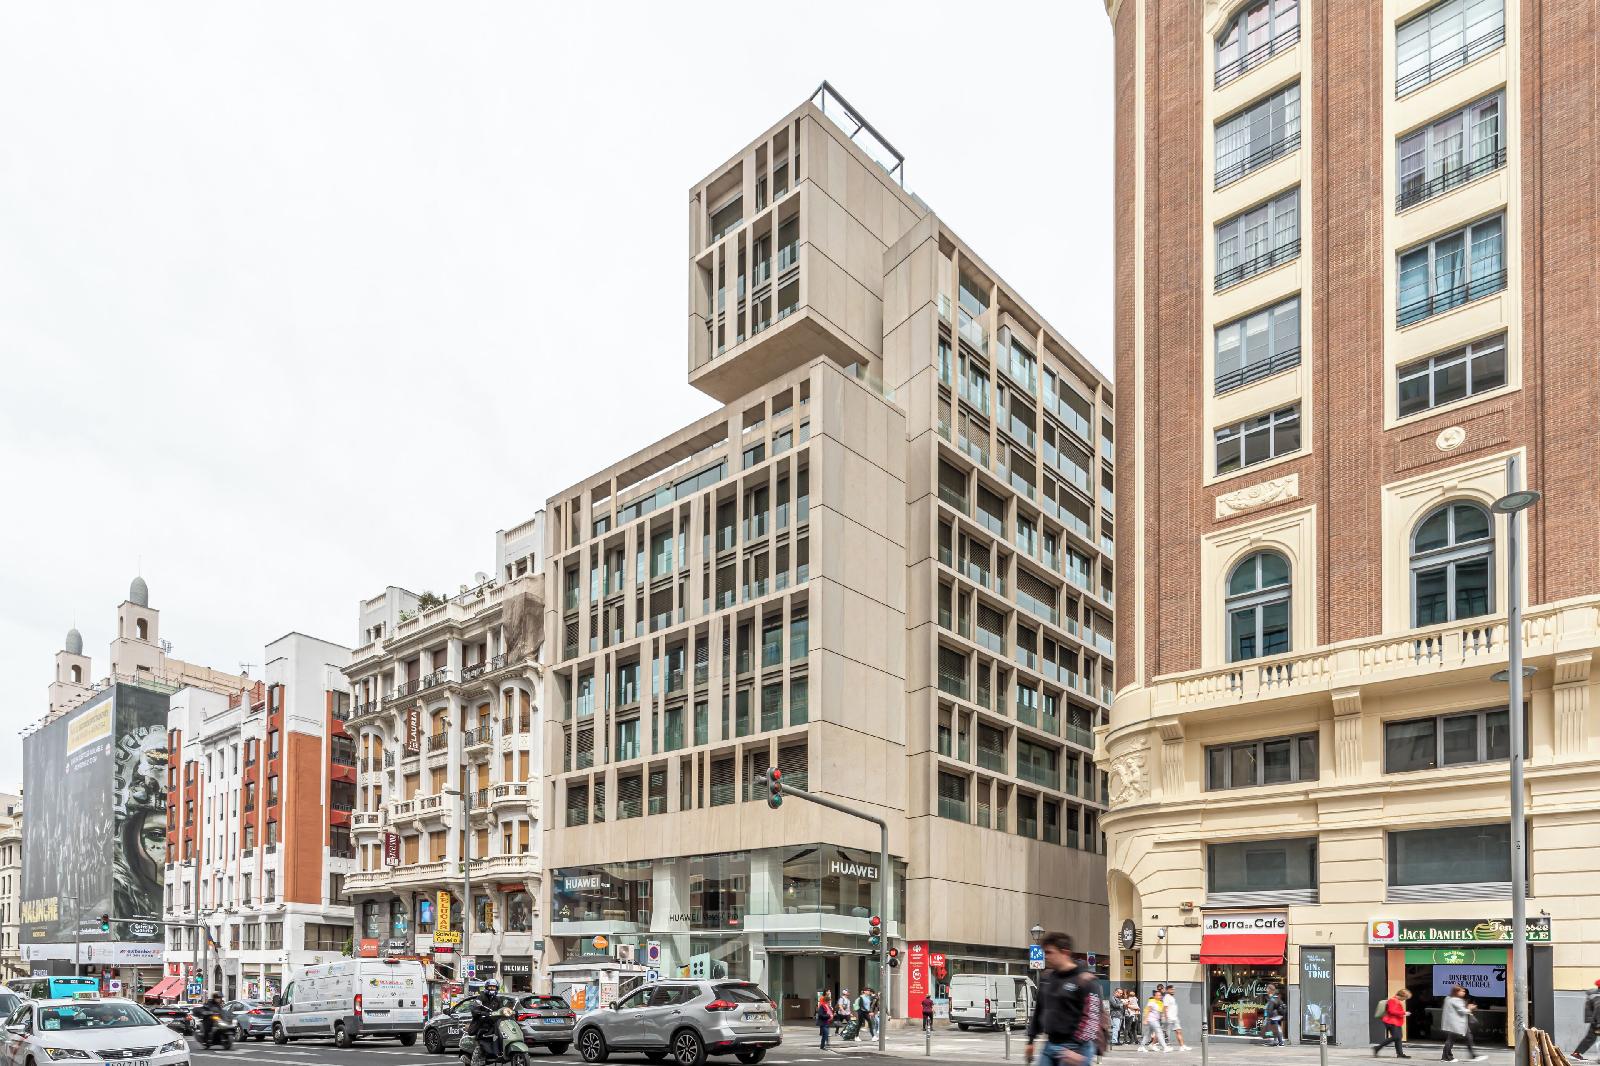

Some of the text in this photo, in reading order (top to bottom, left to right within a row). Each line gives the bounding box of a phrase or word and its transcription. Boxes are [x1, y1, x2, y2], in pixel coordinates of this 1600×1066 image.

[831, 861, 878, 879] HUAWEI
[565, 877, 599, 889] HUAWEI
[1213, 919, 1245, 929] Borra
[1254, 918, 1286, 928] Café
[1399, 928, 1473, 940] JACK DANIEL'S
[1304, 963, 1318, 971] GIN
[1308, 970, 1331, 979] TONIC
[447, 1026, 460, 1035] Uber
